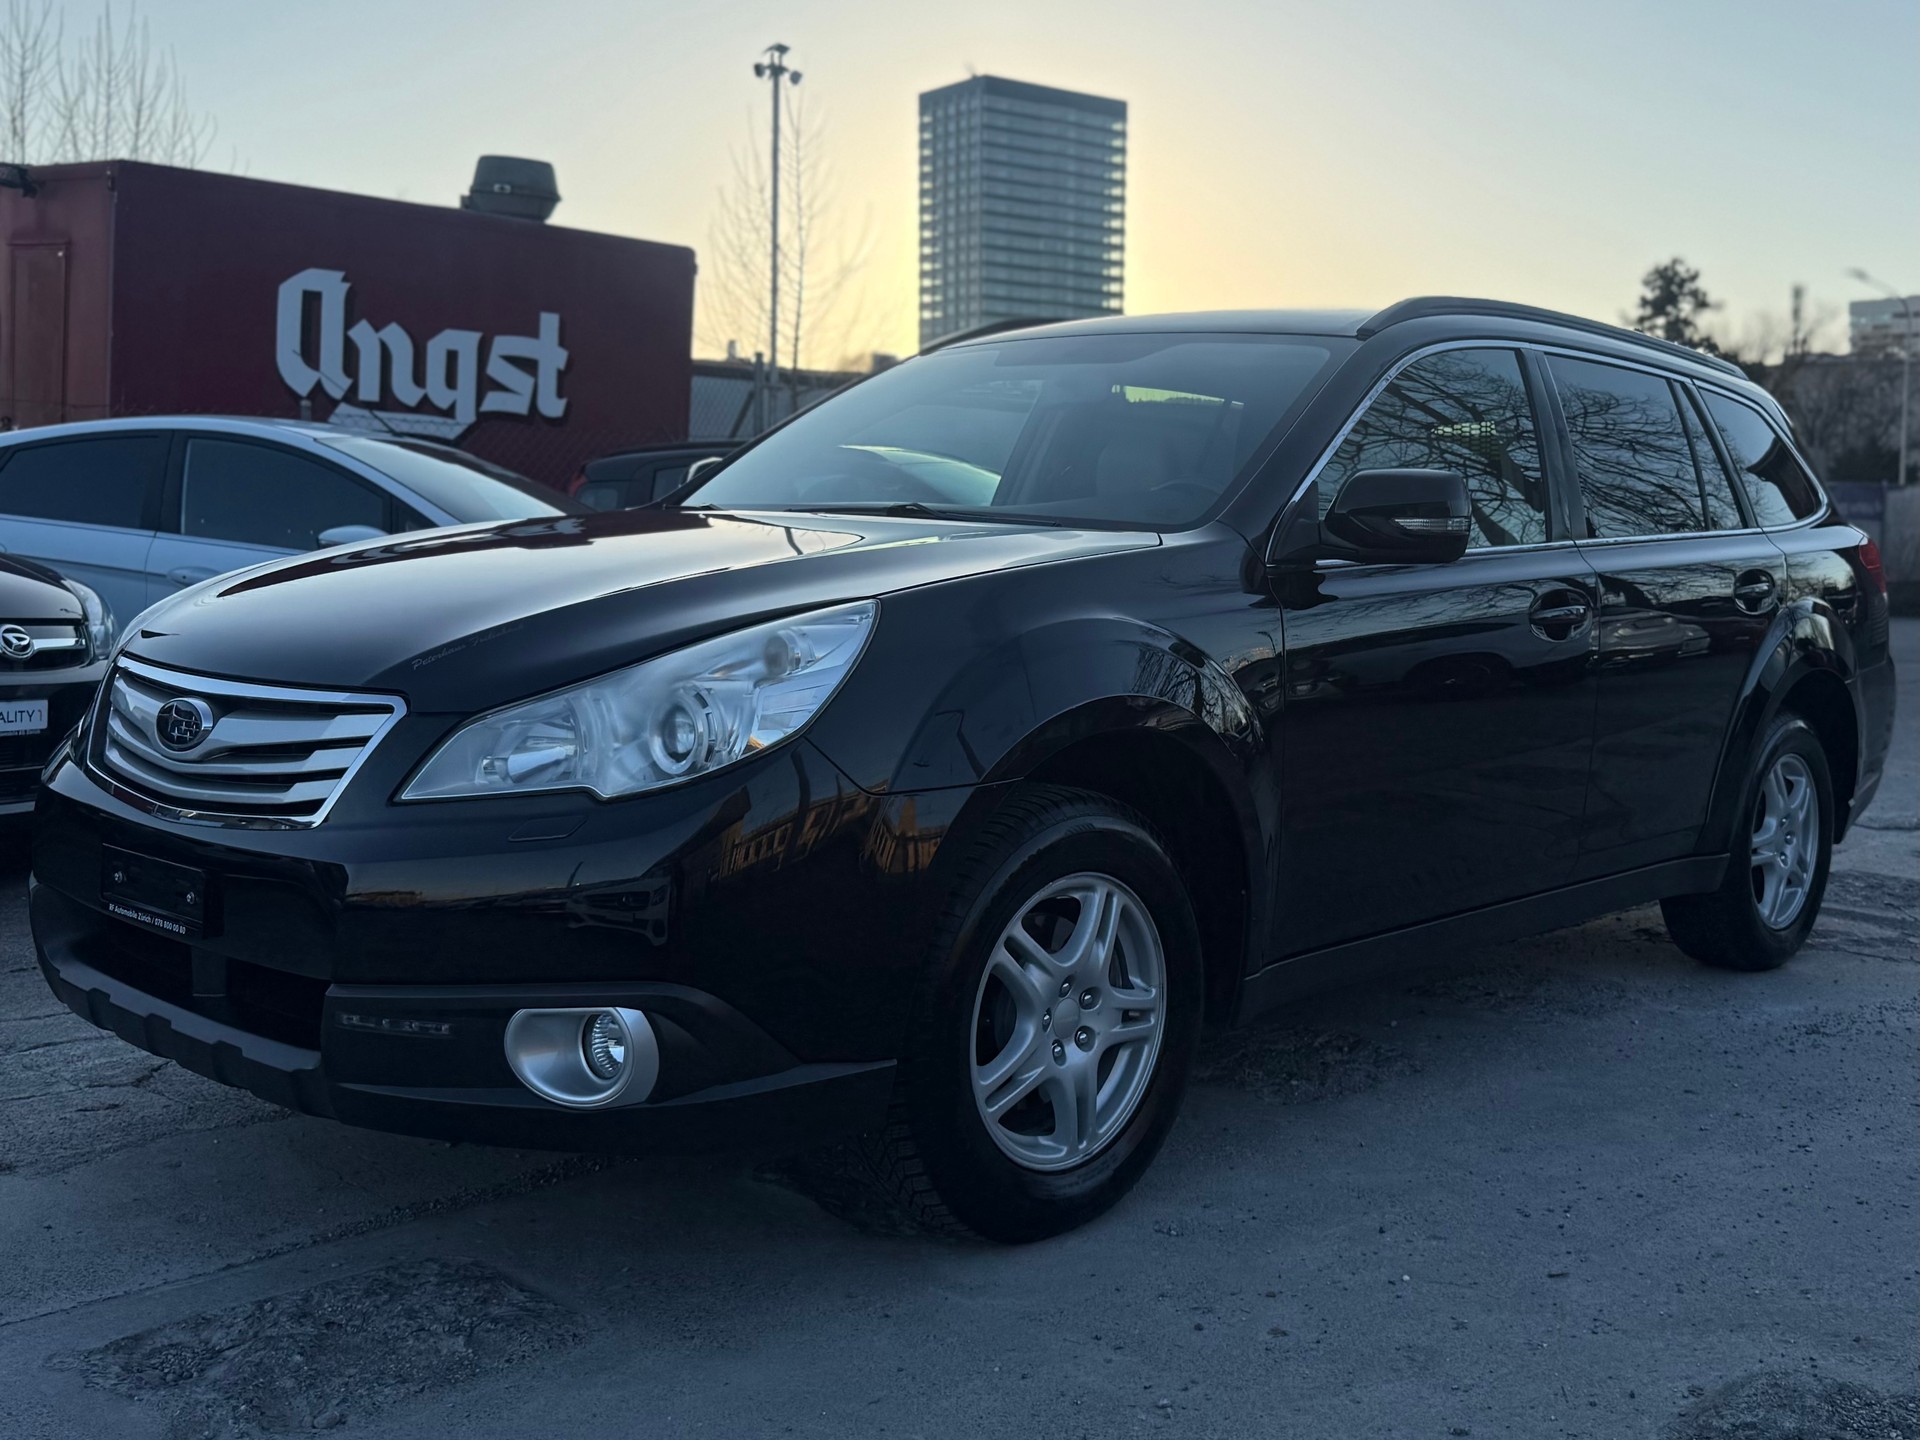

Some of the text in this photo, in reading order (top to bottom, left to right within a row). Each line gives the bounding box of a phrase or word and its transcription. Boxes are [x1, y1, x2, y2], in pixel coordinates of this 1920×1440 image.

[276, 267, 569, 439] Angst
[115, 906, 138, 919] Automobile
[138, 912, 151, 923] Zürich
